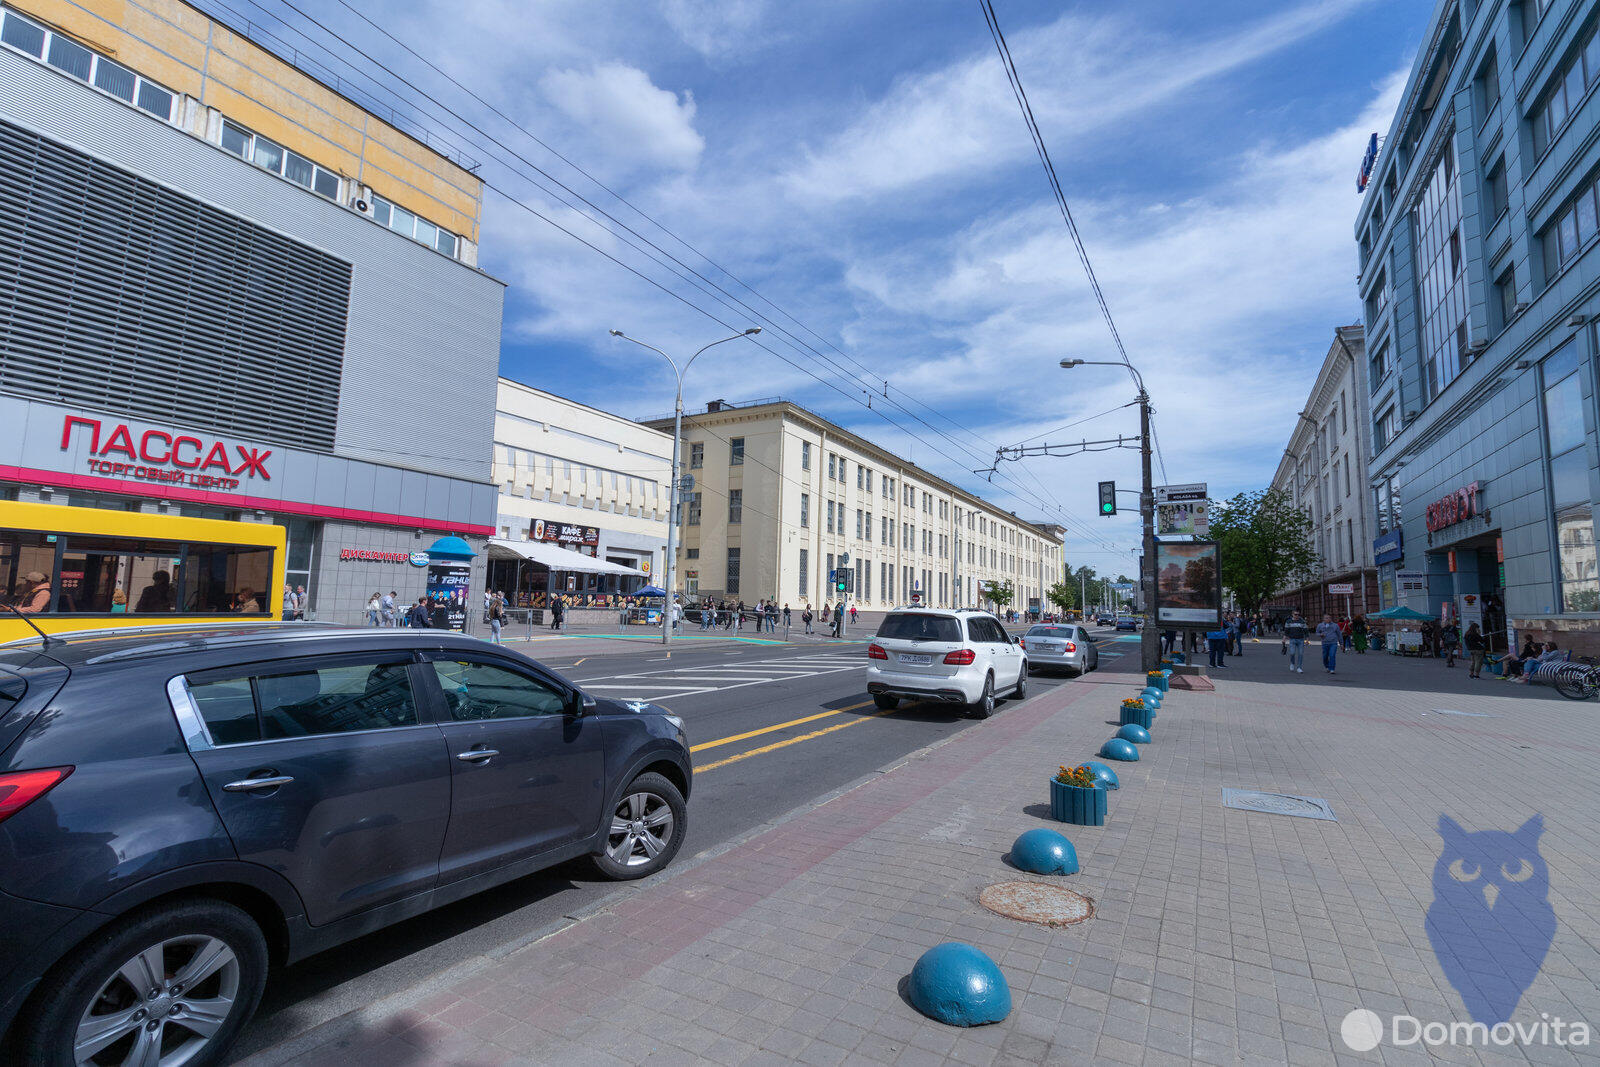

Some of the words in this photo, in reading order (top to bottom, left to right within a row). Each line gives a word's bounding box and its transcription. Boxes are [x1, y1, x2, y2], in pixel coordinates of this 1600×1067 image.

[61, 415, 272, 480] ПАССАЖ
[88, 458, 186, 483] ТОРГОВЫЙ
[190, 472, 240, 489] ЦЕНТР
[562, 526, 582, 537] КАФЕ
[341, 548, 409, 562] ДИСКАУНТЕР
